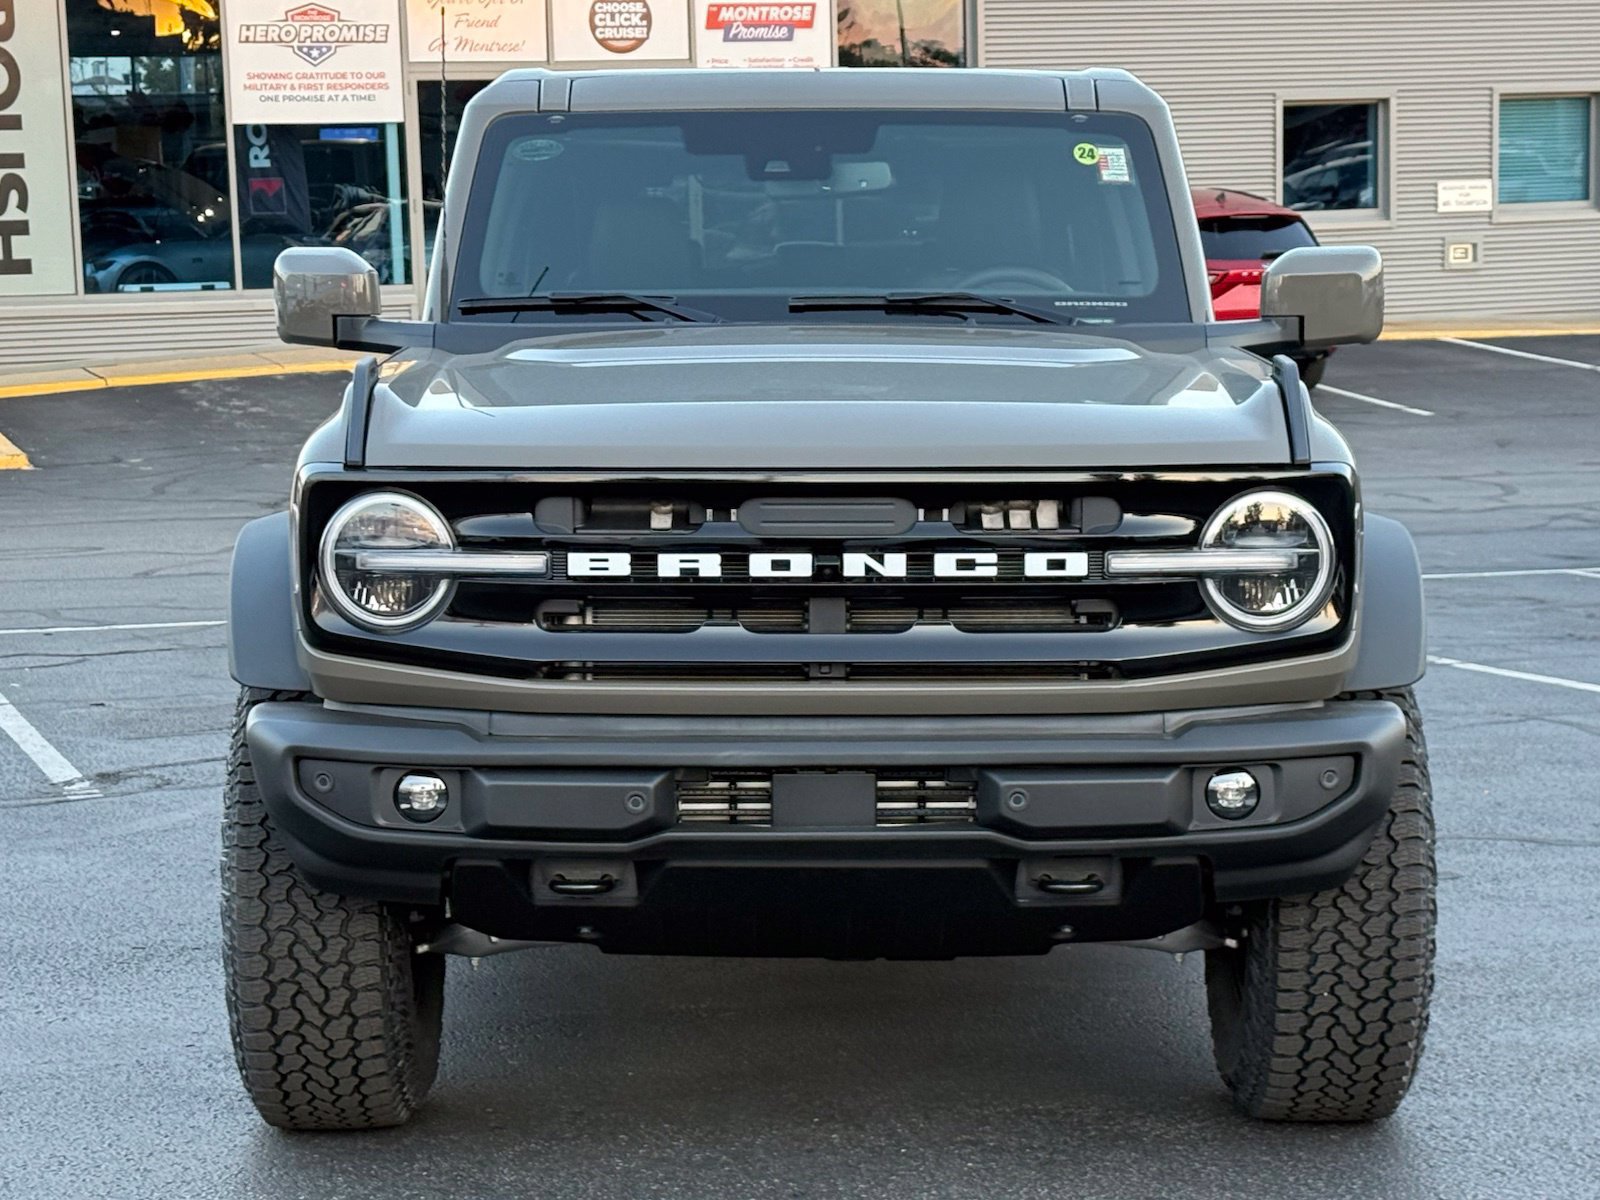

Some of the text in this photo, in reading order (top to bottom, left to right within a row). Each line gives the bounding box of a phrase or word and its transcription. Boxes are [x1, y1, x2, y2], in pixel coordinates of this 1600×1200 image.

[454, 13, 502, 28] Friend
[594, 13, 648, 26] CLICK.
[718, 6, 813, 21] MONTROSE
[239, 24, 389, 43] HERO PROMISE
[729, 22, 789, 39] Promise
[454, 35, 526, 52] Montrose!
[246, 72, 386, 80] SHOWING GRATITUDE TO OUR
[243, 82, 390, 91] MILITARY & FIRST RESPONDERS
[259, 95, 280, 103] ONE
[282, 94, 325, 103] PROMISE
[327, 94, 339, 102] AT
[341, 94, 350, 102] A
[1077, 147, 1096, 160] 24
[567, 552, 1089, 577] BRONCO
